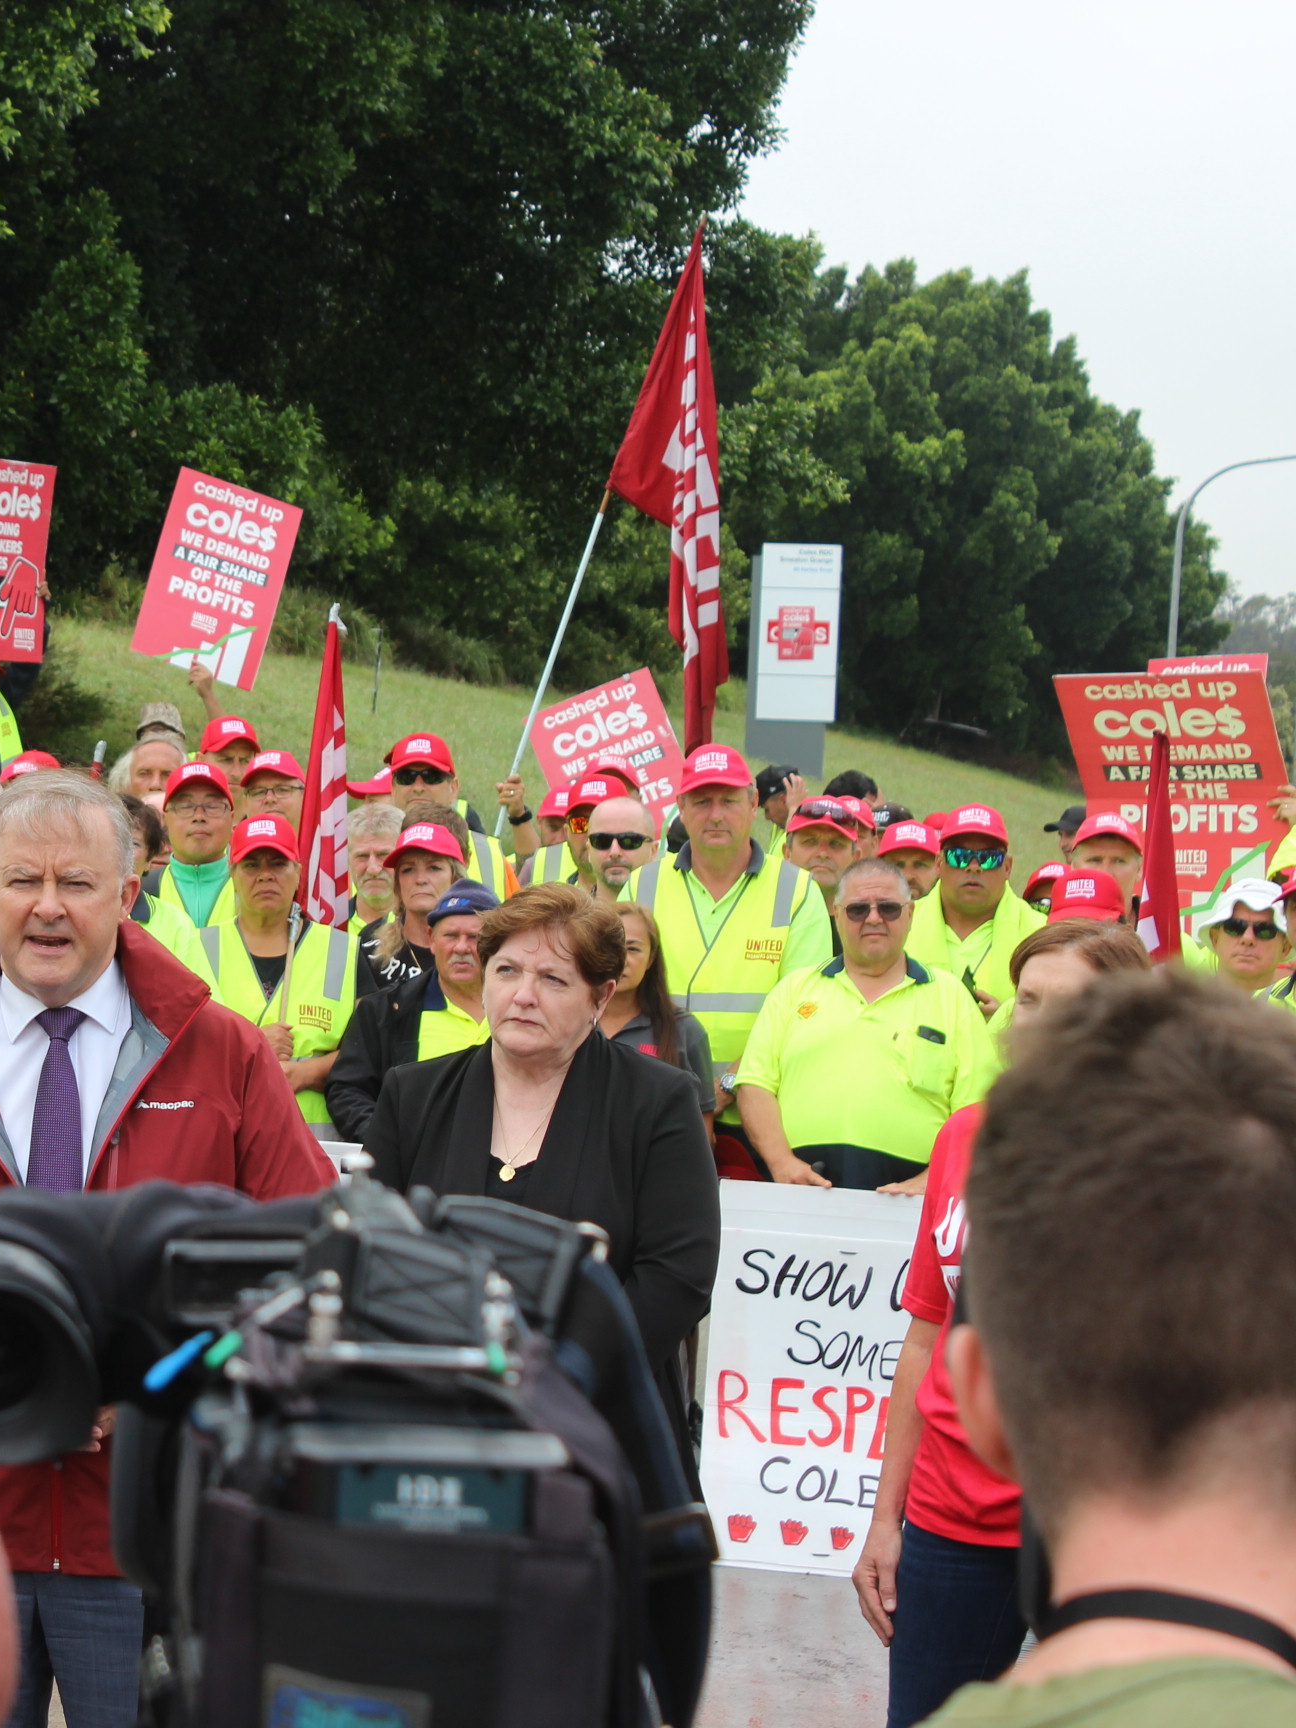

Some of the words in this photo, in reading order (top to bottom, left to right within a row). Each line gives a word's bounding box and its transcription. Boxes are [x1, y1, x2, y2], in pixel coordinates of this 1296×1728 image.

[29, 473, 44, 489] up
[193, 481, 258, 512] cashed
[260, 503, 284, 523] up
[186, 502, 277, 551] cole$
[180, 528, 203, 547] WE
[205, 536, 271, 570] DEMAND
[174, 546, 185, 560] A
[187, 550, 219, 570] FAIR
[219, 560, 267, 587] SHARE
[190, 566, 211, 583] OF
[214, 573, 243, 595] THE
[168, 575, 255, 619] PROFITS
[192, 611, 218, 627] UNITED
[14, 628, 35, 640] UNITED
[1084, 679, 1191, 701] cashed
[1197, 680, 1237, 701] up
[543, 690, 609, 729] cashed
[611, 683, 636, 701] up
[221, 720, 244, 730] UNITED
[1093, 701, 1246, 739] cole$
[553, 702, 648, 757] cole$
[408, 738, 431, 749] UNITED
[254, 752, 281, 765] UNITED
[628, 745, 664, 768] ARE
[695, 752, 727, 764] UNITED
[1101, 745, 1140, 762] WE
[182, 764, 210, 775] UNITED
[561, 757, 587, 777] WE
[1109, 766, 1126, 781] A
[1128, 765, 1179, 781] FAR
[1183, 763, 1258, 780] SHARE
[582, 781, 607, 790] UNITED
[1144, 783, 1177, 799] F
[1181, 782, 1229, 800] THE
[556, 792, 569, 800] UNI
[959, 808, 991, 819] UNITED
[248, 820, 275, 830] UNITED
[404, 825, 433, 837] UNITED
[896, 824, 926, 835] UNITED
[1175, 848, 1208, 864] NITED
[1039, 864, 1064, 876] UNITED
[1066, 879, 1094, 890] UNITED
[746, 939, 783, 951] UNITED
[299, 1005, 332, 1021] UNITED
[149, 1100, 194, 1110] macpac
[735, 1248, 874, 1311] SHOW
[786, 1319, 905, 1382] SOME
[717, 1369, 891, 1461] RESPE
[759, 1455, 882, 1509] COLE
